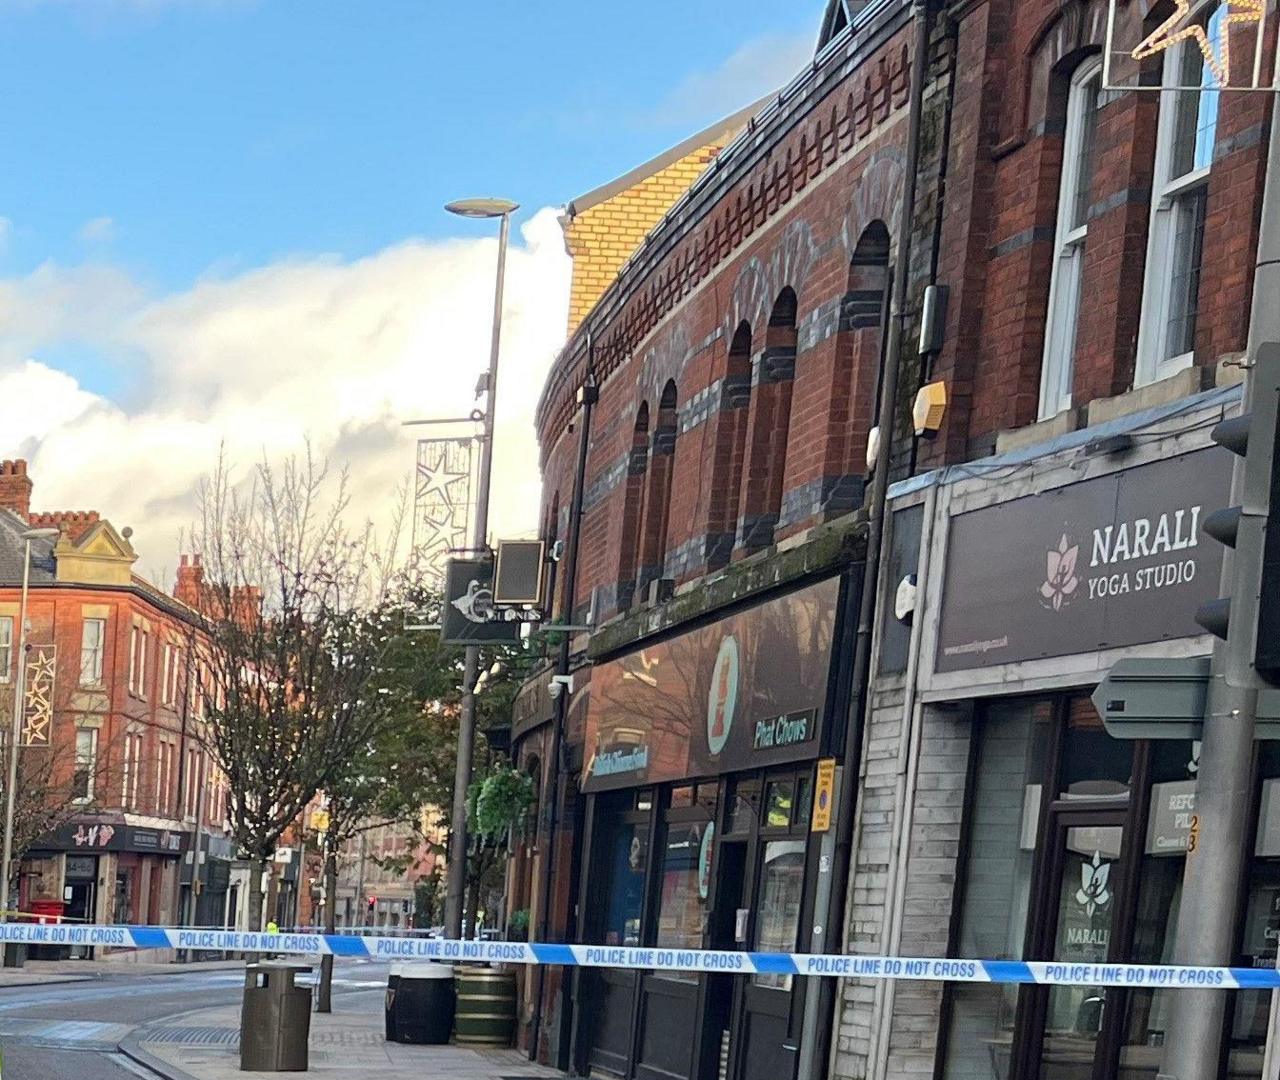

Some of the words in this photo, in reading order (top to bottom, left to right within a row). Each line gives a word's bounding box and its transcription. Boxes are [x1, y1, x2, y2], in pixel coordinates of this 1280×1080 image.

[1089, 505, 1202, 568] NARALI
[1088, 574, 1130, 600] YOGA
[1134, 559, 1196, 591] STUDIO
[754, 719, 776, 750] Phat
[774, 715, 808, 743] Chows
[27, 926, 49, 941] LINE
[51, 927, 65, 942] DO
[68, 927, 87, 943] NOT
[88, 928, 125, 944] CROSS
[179, 932, 214, 948] POLICE
[216, 933, 239, 949] LINE
[242, 933, 258, 949] DO
[260, 934, 280, 950] NOT
[283, 935, 320, 951] CROSS
[1066, 927, 1108, 945] NARALI
[376, 940, 414, 955] POLICE
[417, 942, 441, 957] LINE
[444, 942, 460, 958] DO
[463, 943, 484, 958] NOT
[487, 944, 525, 960] CROSS
[585, 948, 625, 964] POLICE
[628, 950, 654, 966] LINE
[656, 950, 673, 967] DO
[676, 951, 699, 968] NOT
[702, 952, 743, 970] CROSS
[807, 957, 850, 974] POLICE
[854, 959, 881, 975] LINE
[883, 959, 901, 976] DO
[904, 960, 930, 977] NOT
[933, 962, 976, 978] CROSS
[1044, 965, 1090, 982] POLICE
[1093, 966, 1122, 983] LINE
[1126, 967, 1144, 984] DO
[1149, 968, 1175, 984] NOT
[1177, 969, 1224, 985] CROSS
